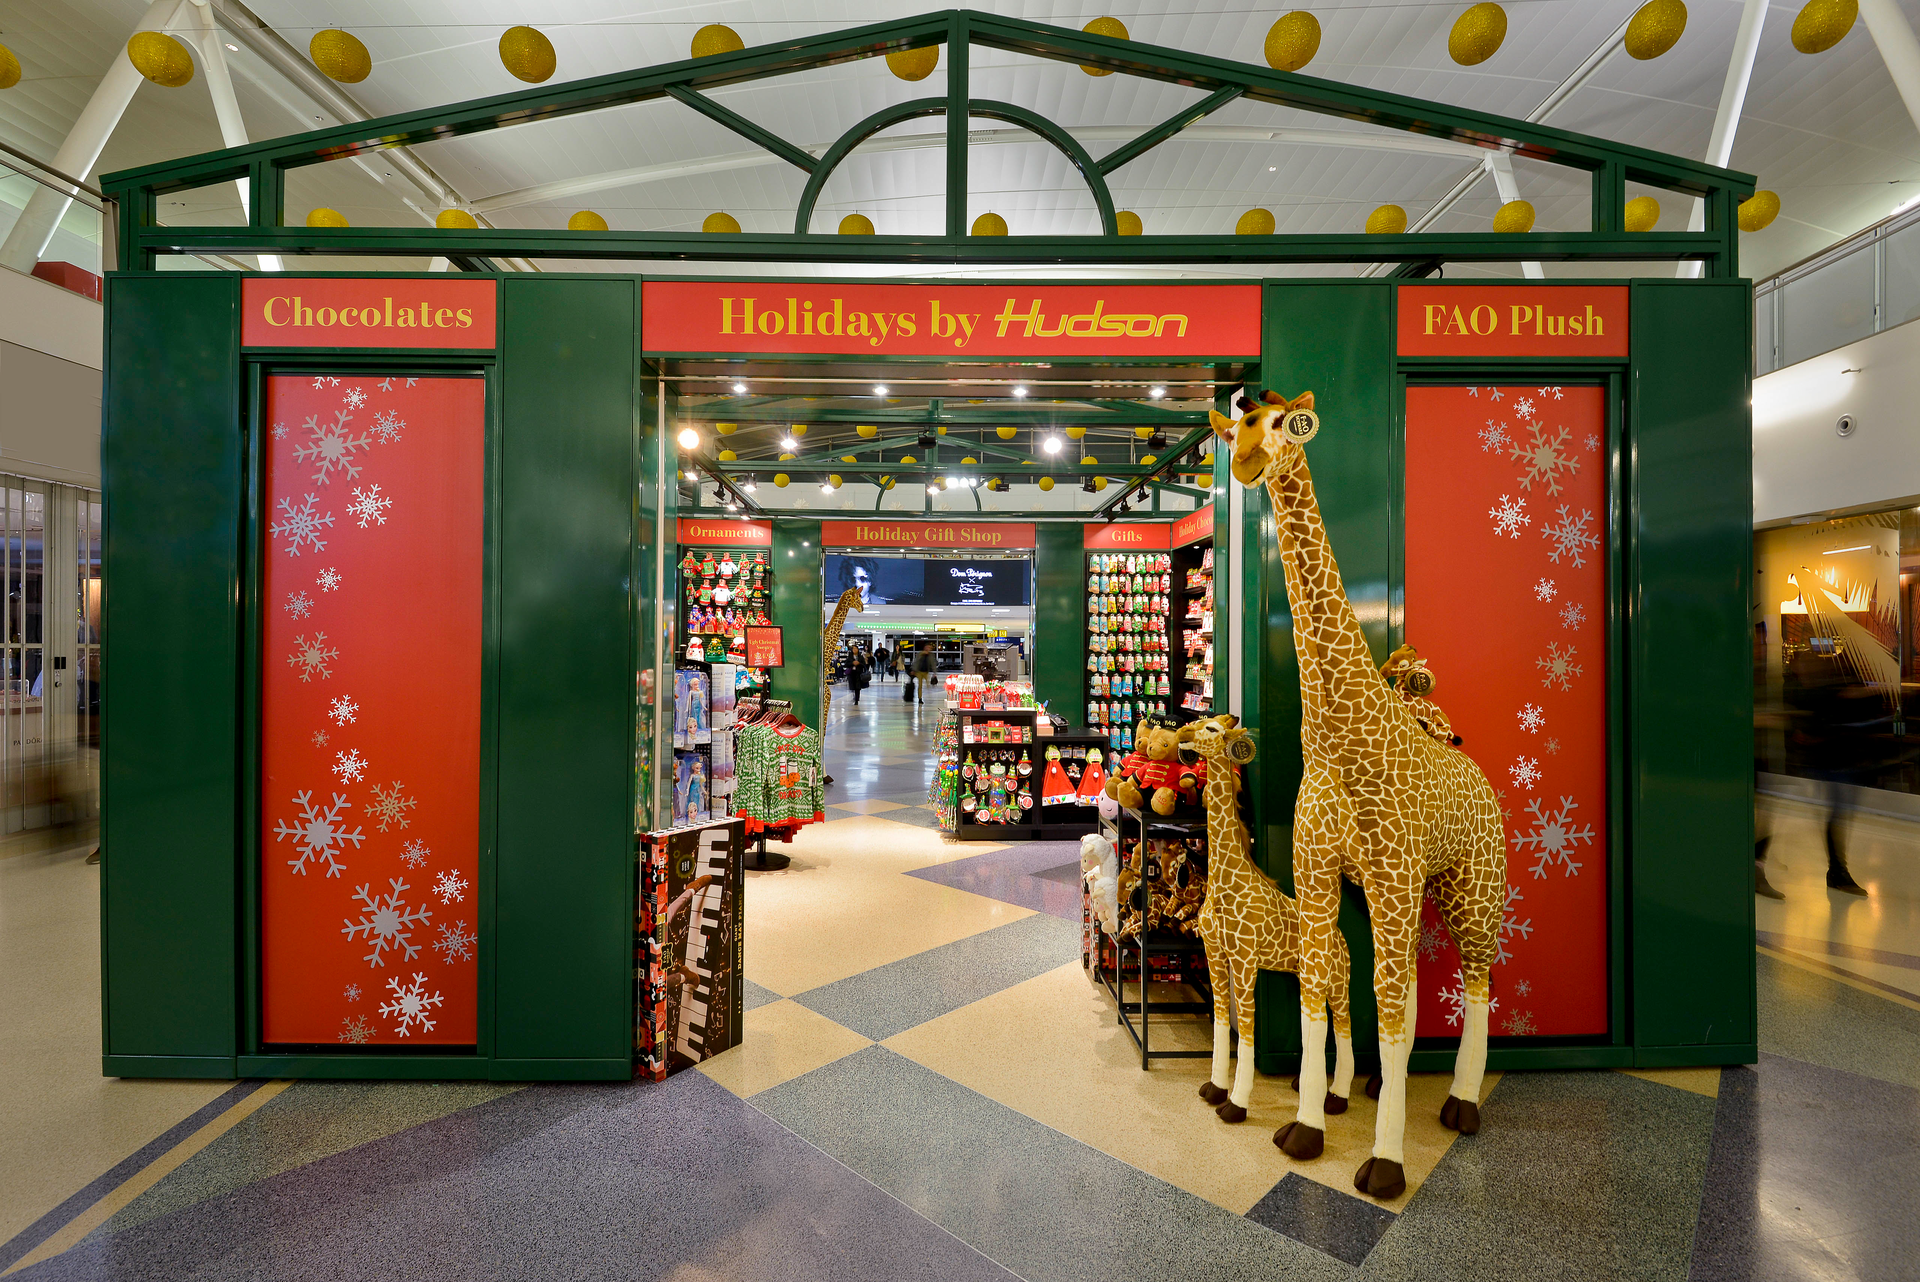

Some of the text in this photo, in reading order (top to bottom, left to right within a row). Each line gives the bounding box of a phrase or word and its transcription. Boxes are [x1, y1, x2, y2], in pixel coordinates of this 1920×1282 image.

[263, 296, 473, 328] Chocolates
[1422, 304, 1605, 336] FAO Plush
[718, 297, 1189, 348] Holidays by Hudson
[1300, 415, 1310, 433] FAO
[690, 525, 764, 538] Ornaments
[855, 526, 1002, 545] Holiday Gift Shop
[1111, 529, 1143, 542] Gifts
[1179, 521, 1196, 538] Holiday
